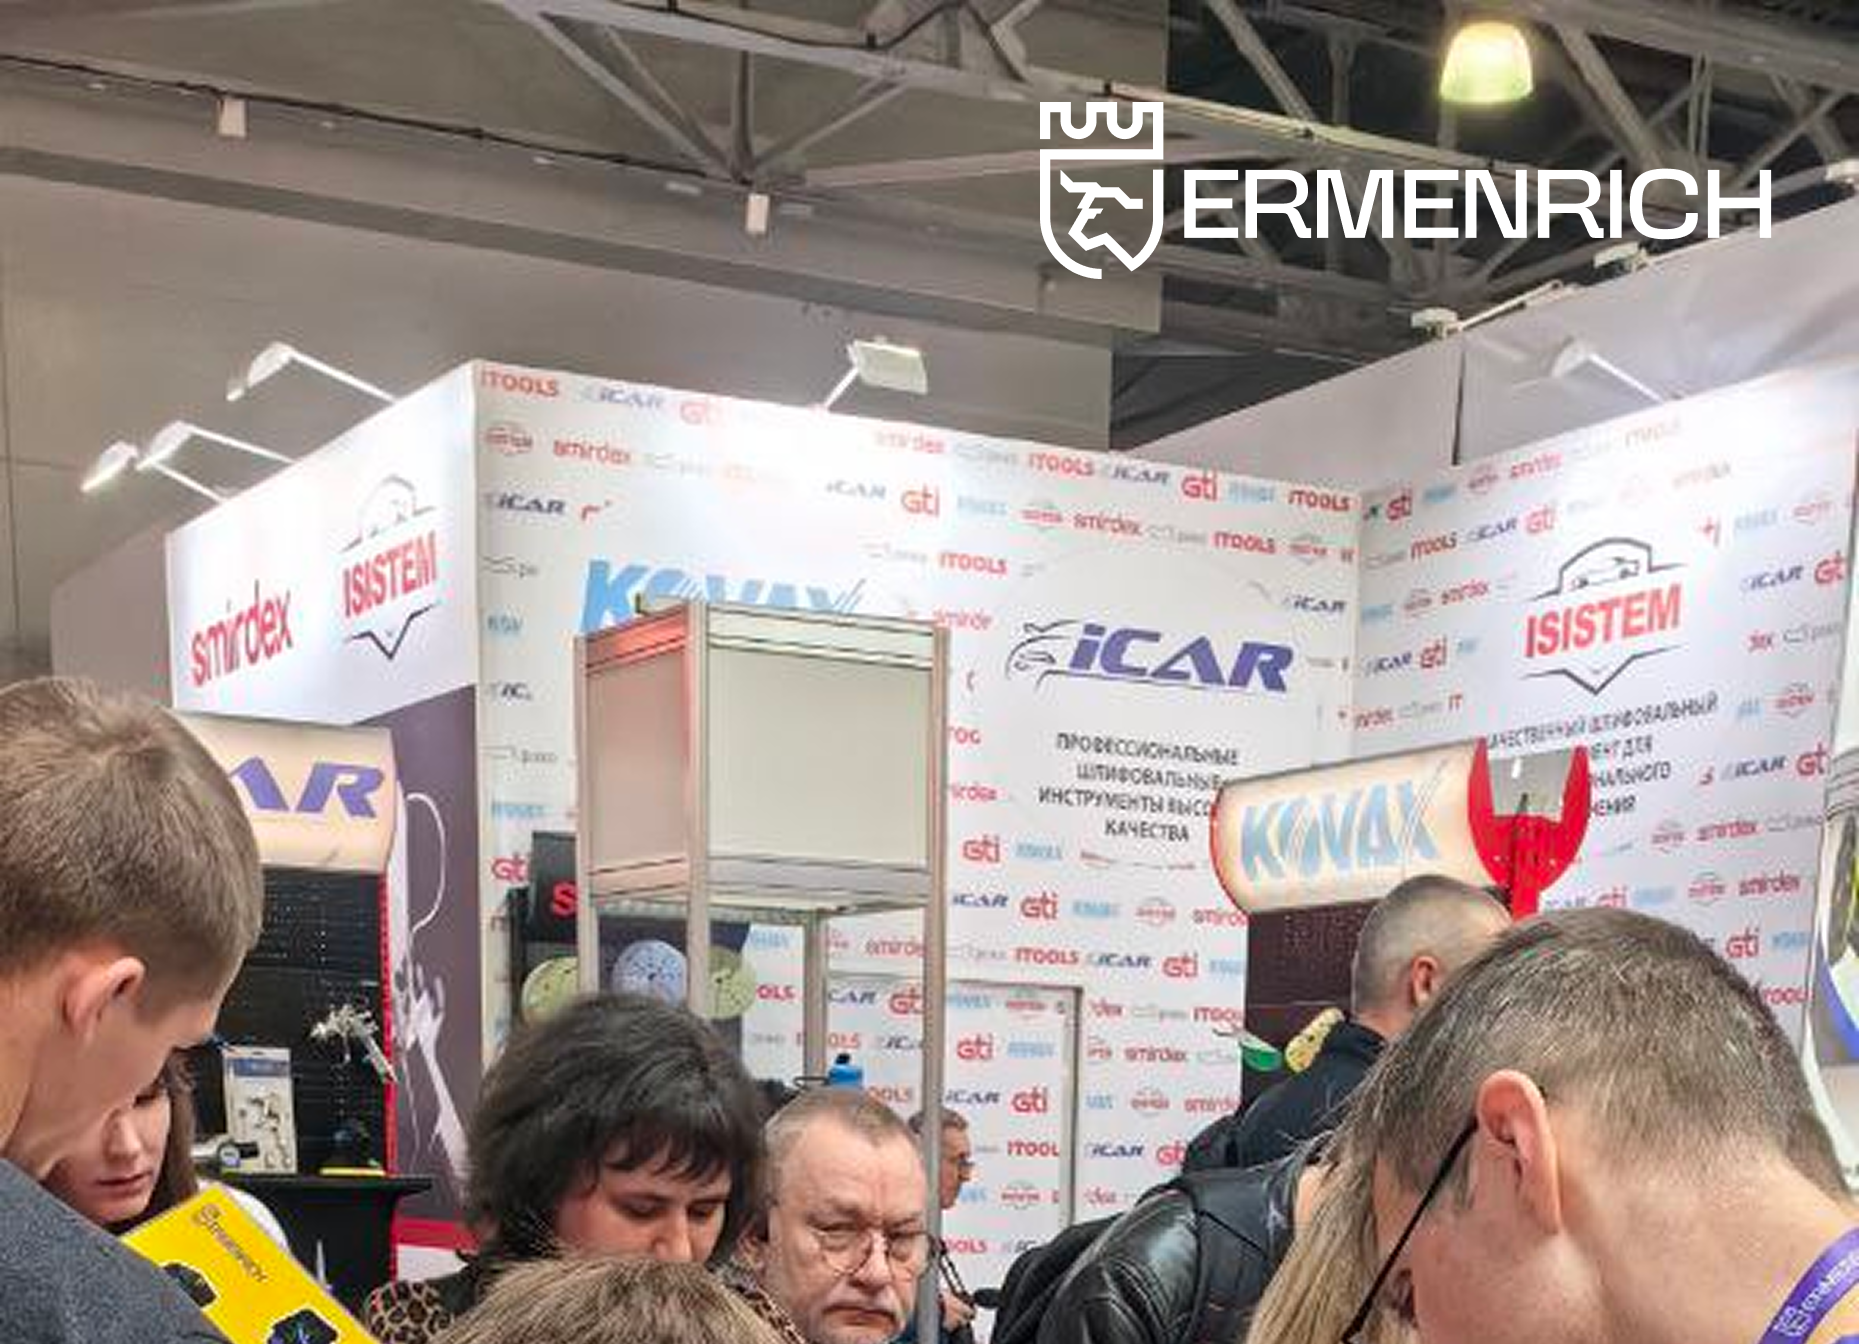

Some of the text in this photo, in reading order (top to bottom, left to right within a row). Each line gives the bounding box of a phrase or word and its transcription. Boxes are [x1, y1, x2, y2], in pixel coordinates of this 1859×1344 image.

[1181, 468, 1217, 501] Gti
[342, 530, 437, 619] ISISTEM
[190, 578, 293, 688] smirdex
[1525, 583, 1682, 657] ISISTEM
[1069, 622, 1294, 692] iCAR
[1056, 731, 1239, 766] ПРОФЕССИОНАЛЬНЫЕ
[1038, 787, 1163, 814] ИНСТРУМЕНТЫ
[1103, 819, 1190, 843] КАЧЕСТВА
[1240, 760, 1450, 882] KOVAX
[963, 835, 1001, 863] Gti
[1020, 891, 1057, 920] Gti
[1016, 946, 1079, 965] ITOOLS
[1726, 926, 1759, 959] Gti
[1163, 951, 1198, 978] Gti
[957, 1033, 994, 1062] Gti
[1012, 1085, 1048, 1114] Gti
